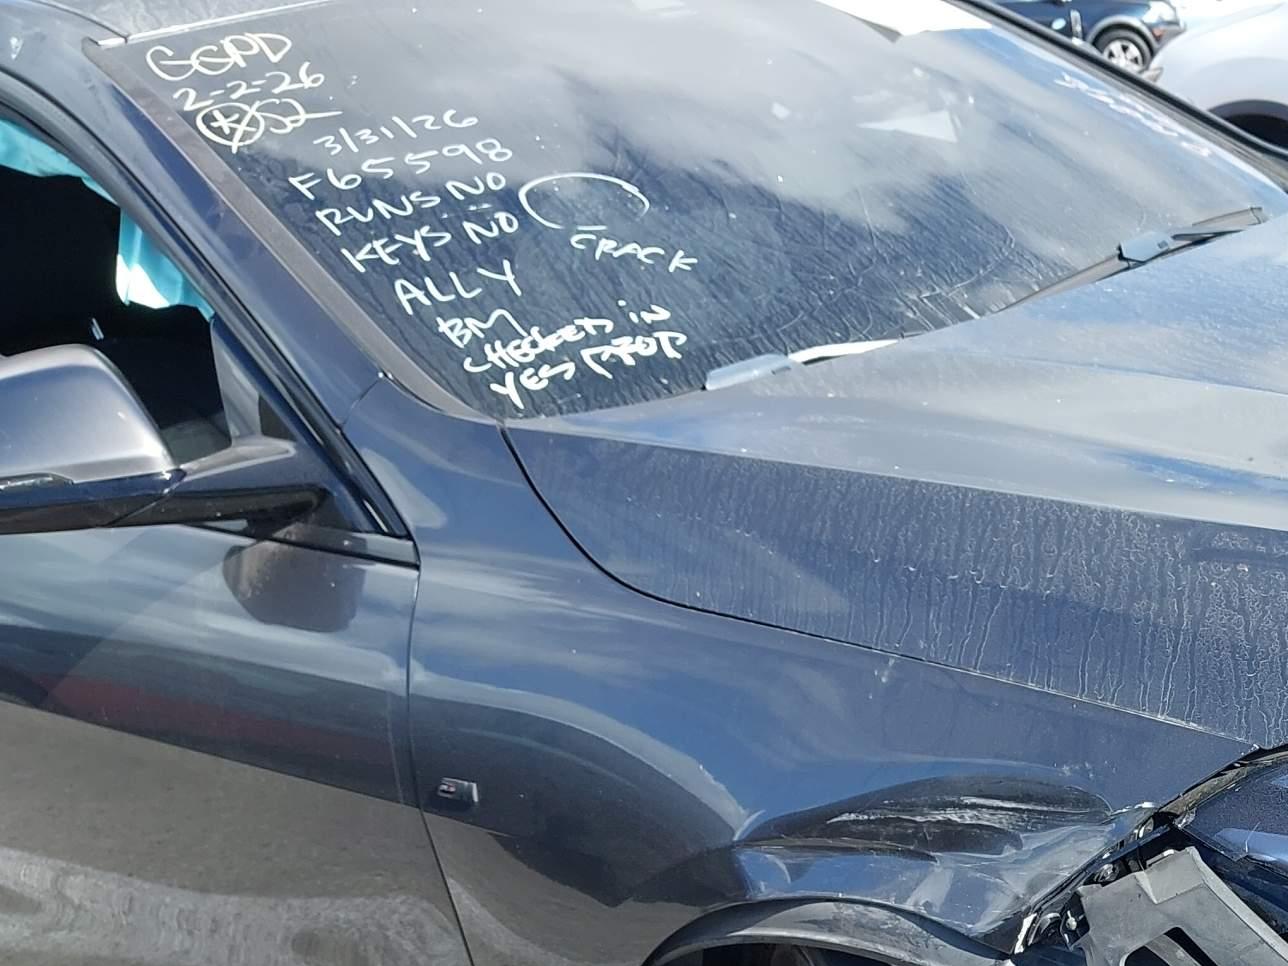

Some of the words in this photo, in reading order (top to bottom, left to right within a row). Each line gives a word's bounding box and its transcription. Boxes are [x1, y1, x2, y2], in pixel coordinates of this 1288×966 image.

[172, 62, 325, 111] 2-2-26
[313, 109, 478, 155] 3/31/26
[288, 138, 513, 200] F65598
[315, 191, 441, 236] RUNS
[445, 172, 506, 200] NO
[341, 226, 452, 273] KEYS
[462, 212, 518, 244] NO
[570, 233, 698, 272] CRACK
[394, 259, 522, 315] ALLY
[489, 361, 576, 409] YES
